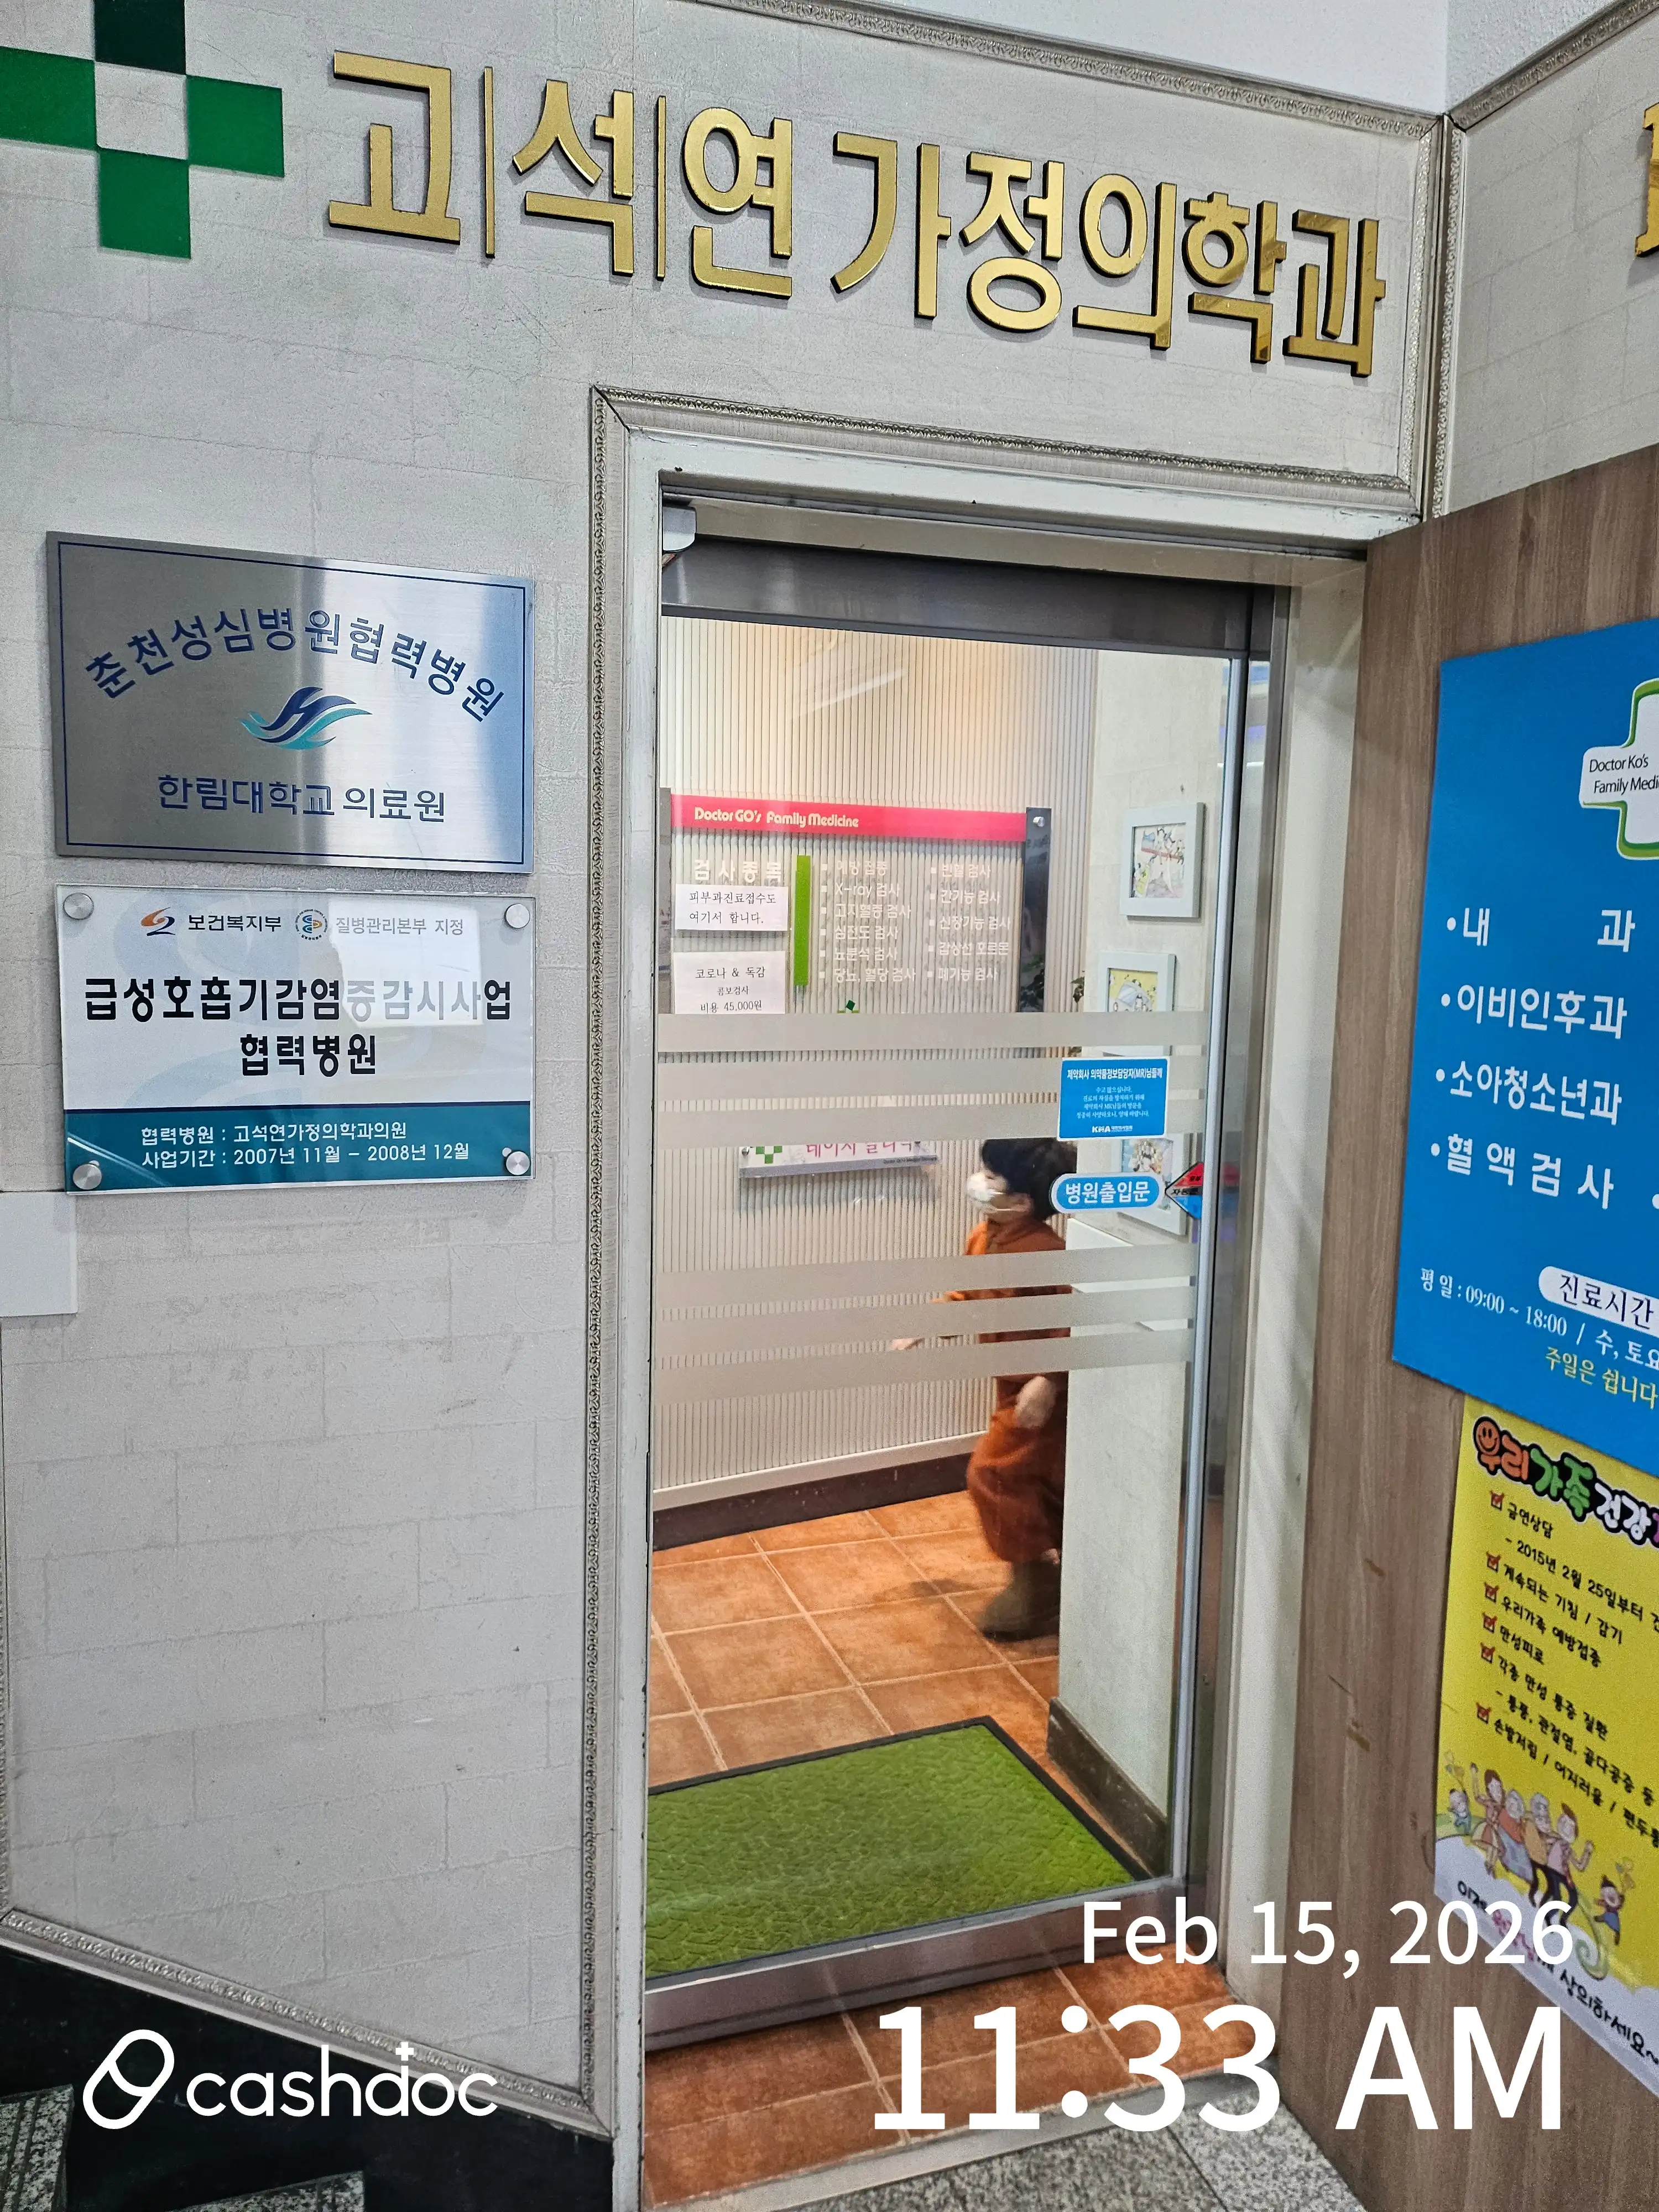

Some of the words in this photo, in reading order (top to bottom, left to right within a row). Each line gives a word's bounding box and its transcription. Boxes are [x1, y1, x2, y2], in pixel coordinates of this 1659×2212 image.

[830, 132, 1386, 377] 가정의학과
[1589, 759, 1626, 773] Doctor
[1628, 754, 1648, 769] Ko's
[1594, 777, 1629, 795] Family
[1630, 774, 1659, 791] Medi
[695, 807, 733, 821] Doctor
[735, 809, 761, 823] GO's
[766, 811, 806, 828] Family
[808, 813, 859, 827] Medicine
[968, 864, 992, 878] 검사
[689, 890, 776, 905] 피부과진료접수도
[835, 882, 873, 898] X-ray
[877, 883, 900, 897] 검사
[978, 890, 1001, 904] 검사
[690, 911, 722, 924] 여기서
[729, 912, 764, 925] 합니다.
[835, 903, 883, 919] 고지혈증
[888, 904, 911, 919] 검사
[188, 915, 281, 932] 보건복지부
[336, 917, 426, 935] 질병관리본부
[435, 919, 463, 935] 지정
[989, 916, 1011, 930] 검사
[834, 925, 870, 940] 심전도
[875, 925, 899, 940] 검사
[874, 947, 898, 961] 검사
[695, 967, 727, 979] 코로나
[732, 967, 739, 977] &
[745, 966, 766, 978] 독감
[893, 968, 916, 982] 검사
[975, 967, 998, 980] 검사
[717, 985, 750, 996] 콤보검사
[700, 1003, 718, 1014] 비용
[1457, 984, 1627, 1040] 이비인후과
[240, 1034, 376, 1077] 협력병원
[1451, 1061, 1623, 1125] 소아청소년과
[141, 1126, 214, 1146] 협력병원
[233, 1122, 406, 1142] 고석연가정의학과의원
[142, 1149, 215, 1169] 사업기간
[234, 1147, 295, 1165] 2007년
[302, 1146, 340, 1164] 11월
[368, 1144, 426, 1162] 2008년
[434, 1142, 469, 1160] 12월
[1066, 1181, 1150, 1204] 병원출입문
[1465, 1285, 1505, 1314] 09:00
[1526, 1306, 1567, 1336] 18:00
[1559, 1274, 1653, 1329] 진료시간
[1545, 1346, 1597, 1385] 주일은
[1602, 1368, 1658, 1411] 쉽니다
[1517, 1540, 1556, 1575] 2015년
[1562, 1565, 1582, 1589] 2월
[1588, 1579, 1643, 1621] 25일부터
[1597, 1617, 1621, 1644] 감기
